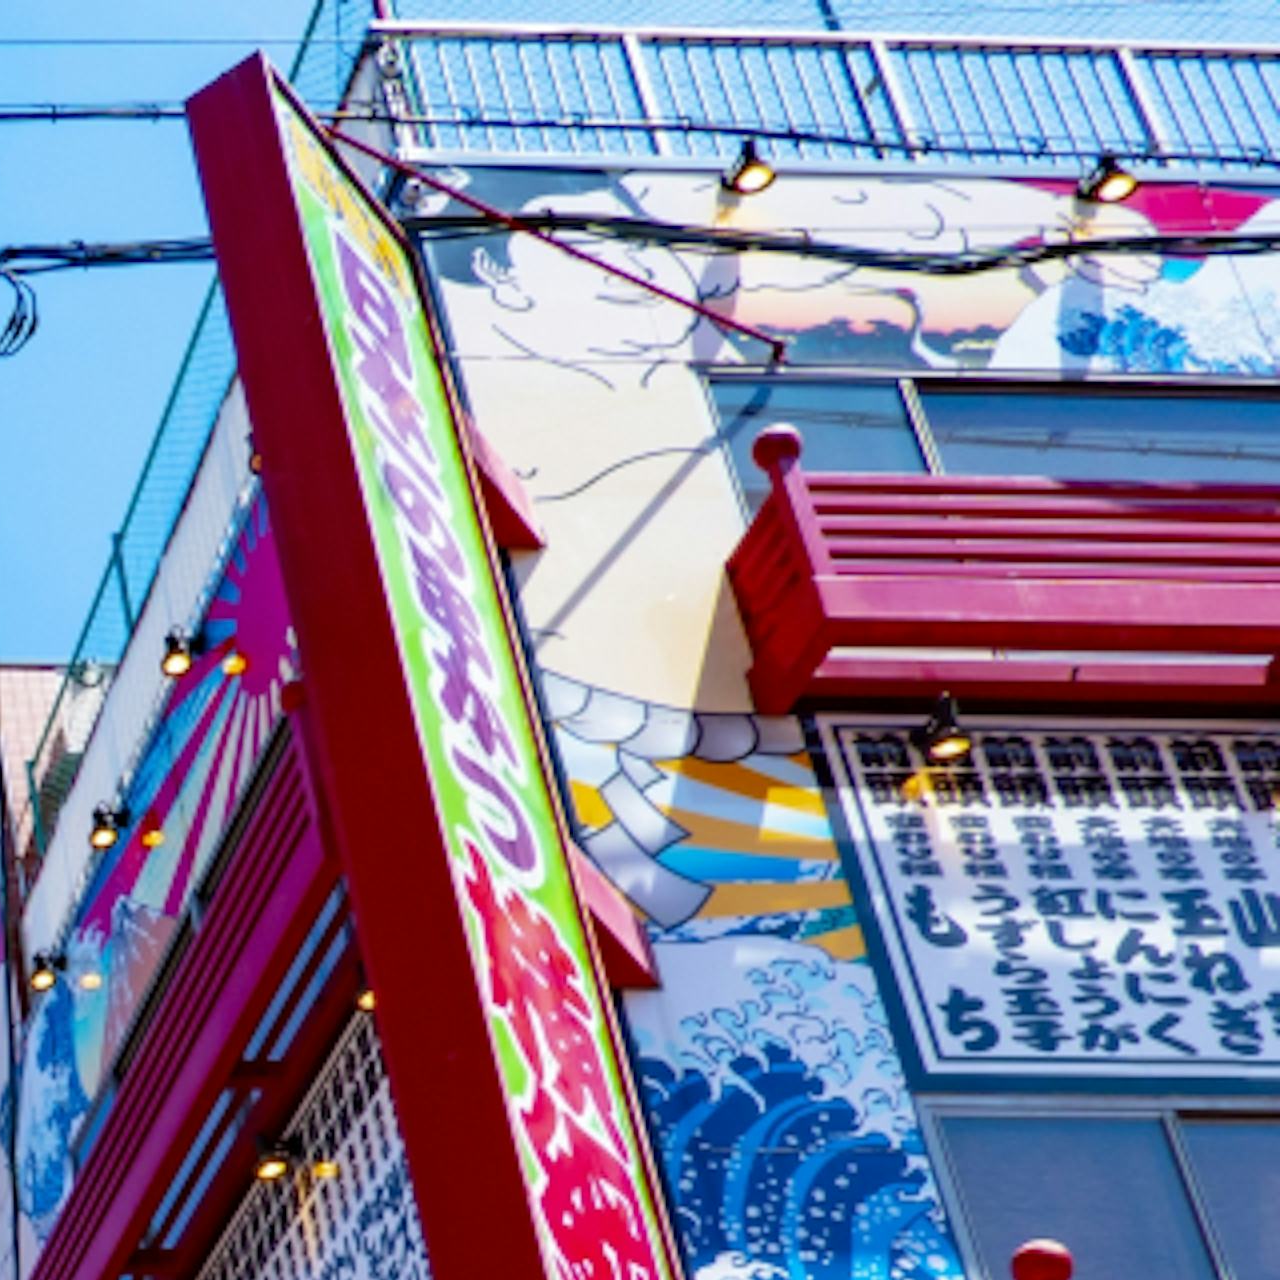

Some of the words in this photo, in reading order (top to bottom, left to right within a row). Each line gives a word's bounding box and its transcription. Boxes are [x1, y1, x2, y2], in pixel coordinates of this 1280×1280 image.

[905, 886, 999, 1052] もち
[1095, 887, 1197, 1054] にんにく
[1160, 887, 1263, 1055] 玉ねぎ
